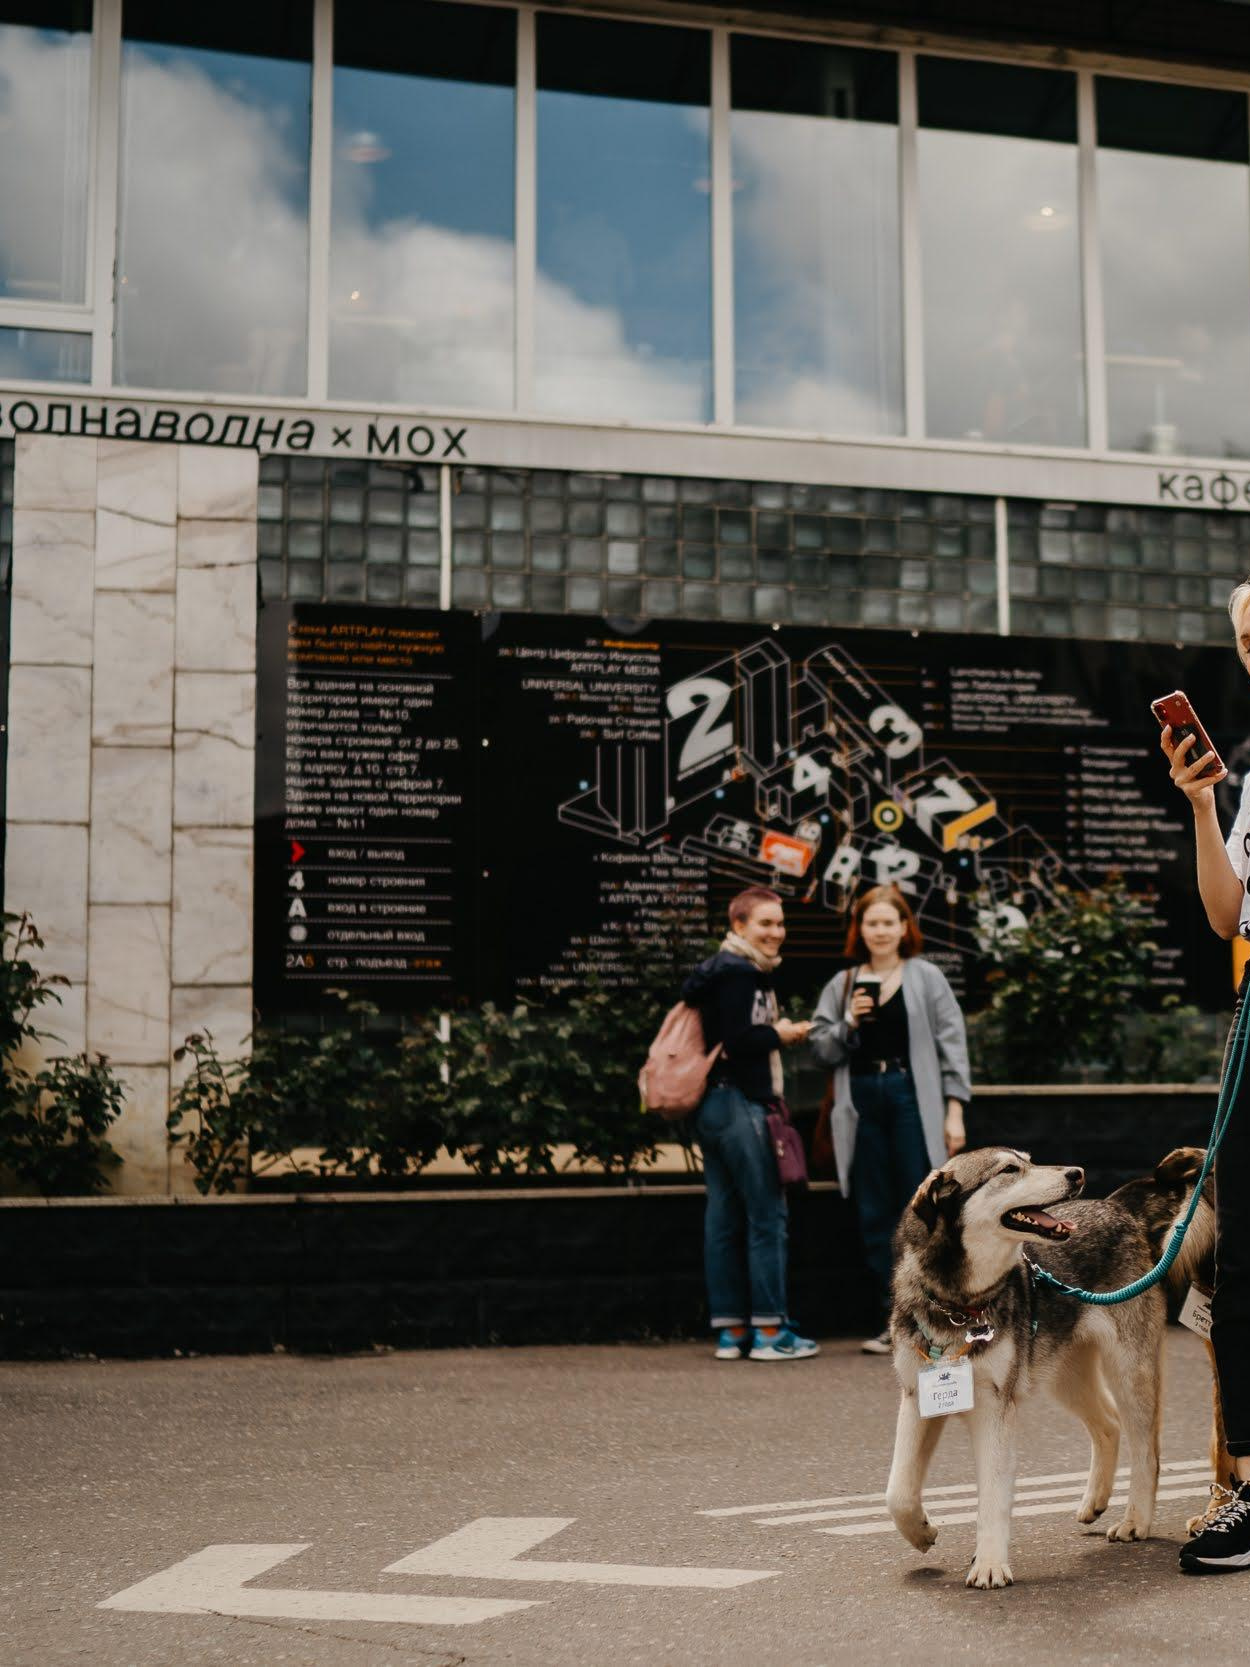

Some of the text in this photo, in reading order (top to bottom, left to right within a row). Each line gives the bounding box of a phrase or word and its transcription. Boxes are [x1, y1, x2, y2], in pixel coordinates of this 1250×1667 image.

[0, 400, 316, 451] олнаволна
[331, 624, 386, 637] ARTPLAY
[570, 663, 660, 676] ARTPLAY MEDIA
[522, 678, 657, 692] UNIVERSAL UNIVERSITY
[666, 677, 734, 781] 2
[328, 848, 357, 861] вход
[367, 849, 405, 861] выход
[288, 870, 305, 890] 4
[328, 876, 426, 888] номер строения
[328, 903, 427, 915] вход в строение
[327, 929, 426, 943] отдельный вход
[932, 1388, 959, 1402] Герда
